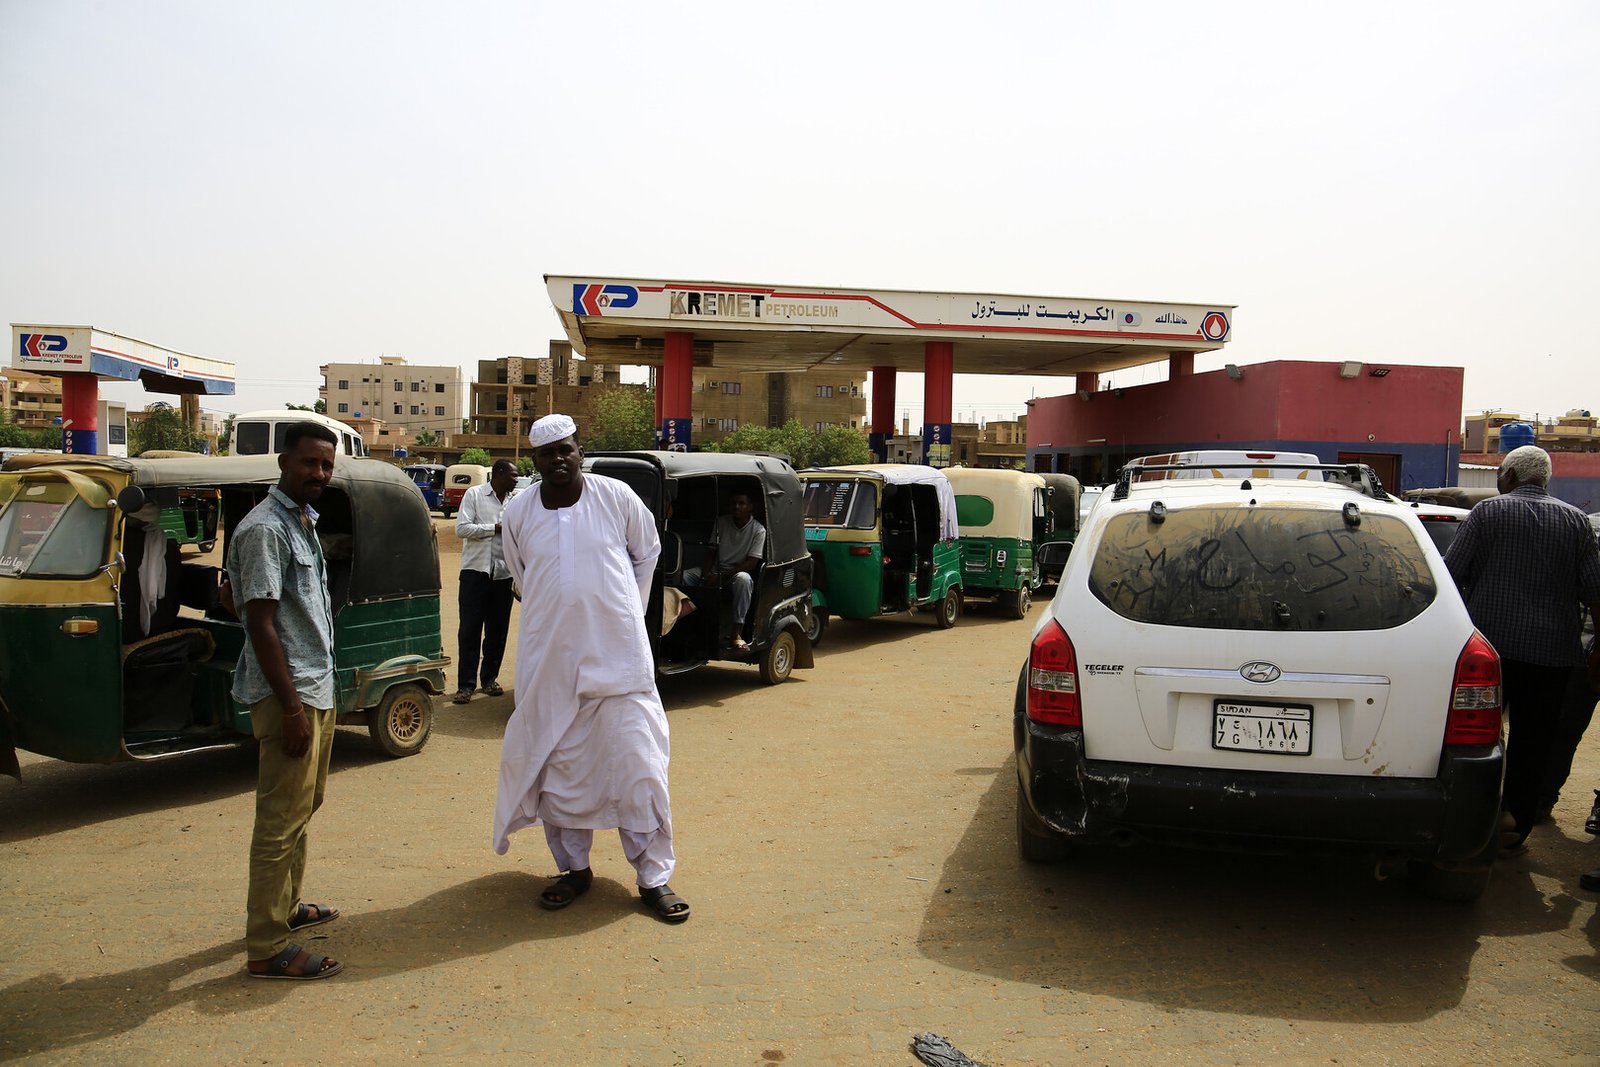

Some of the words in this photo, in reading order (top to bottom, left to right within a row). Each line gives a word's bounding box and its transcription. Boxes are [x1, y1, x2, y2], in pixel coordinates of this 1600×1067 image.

[671, 291, 765, 318] KREMET
[766, 303, 839, 318] PETROLEUM
[971, 301, 1030, 321] للبترول
[1036, 306, 1114, 324] الكريمت
[1220, 705, 1252, 714] SUDAN
[1232, 733, 1241, 745] G
